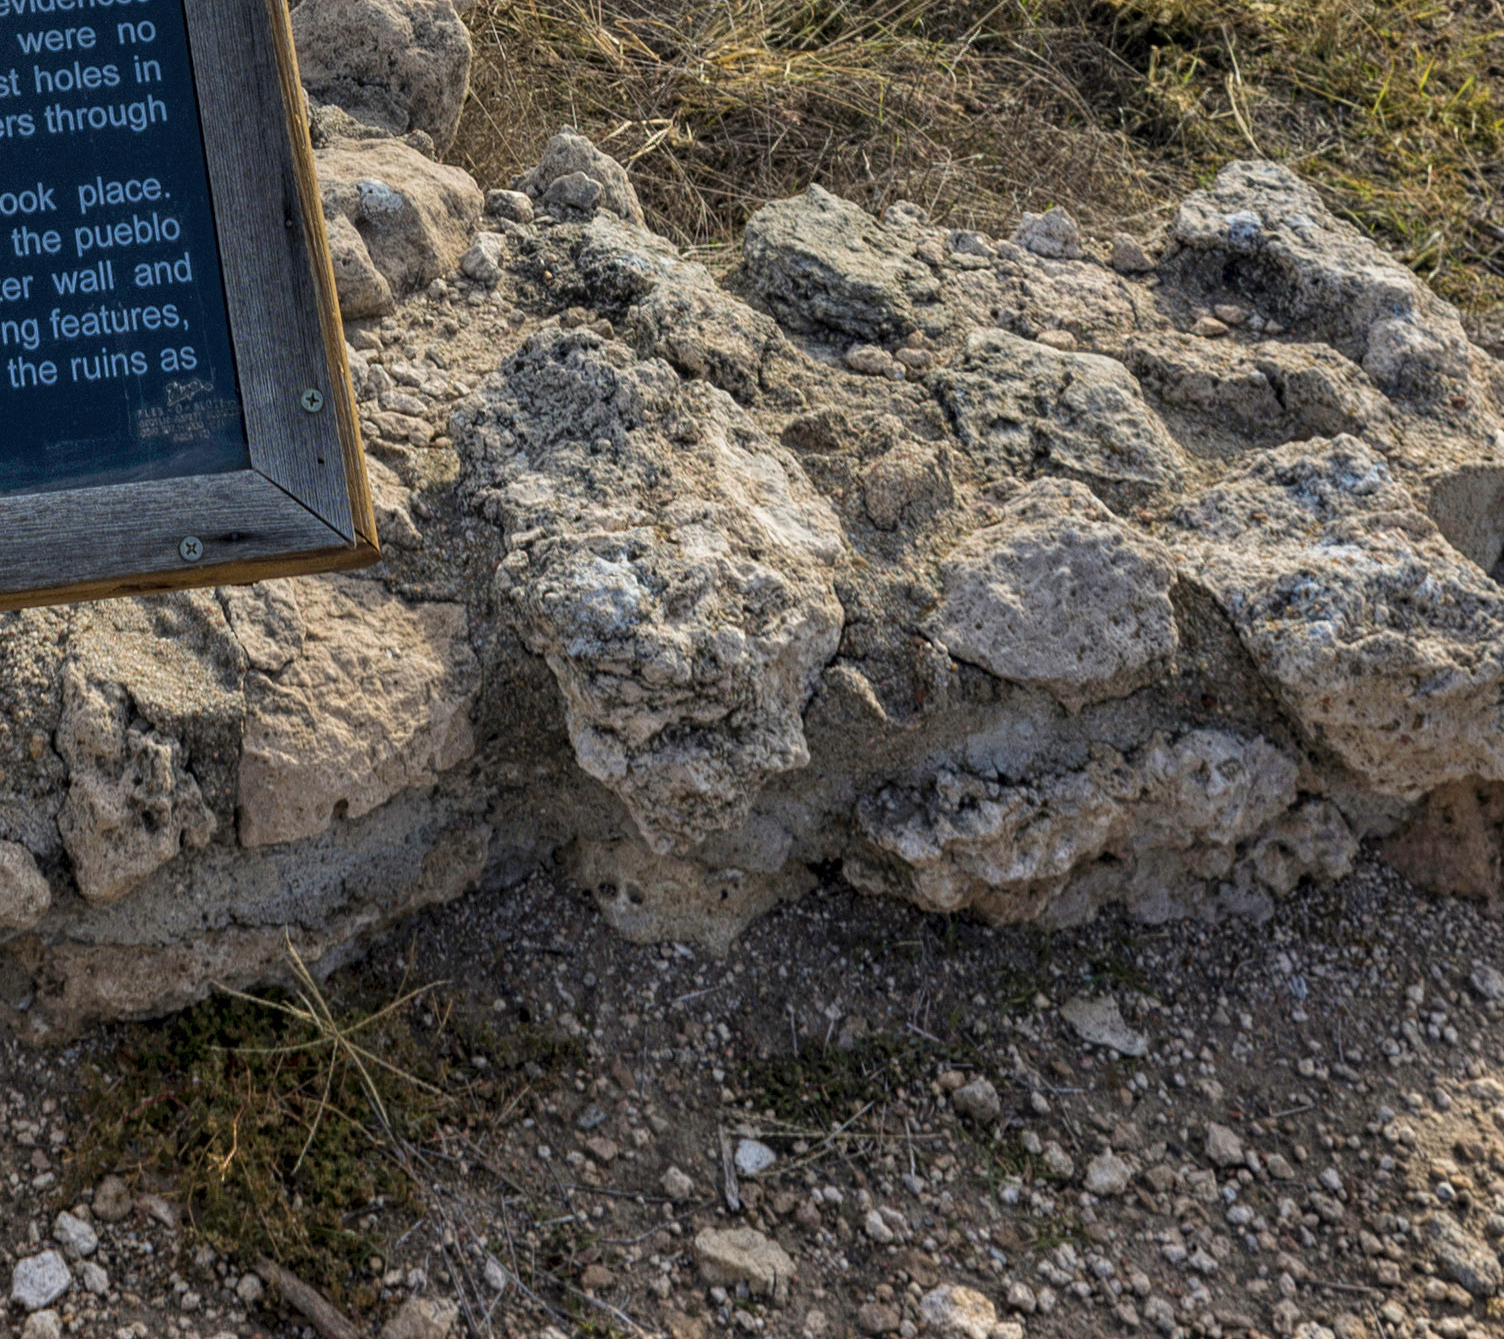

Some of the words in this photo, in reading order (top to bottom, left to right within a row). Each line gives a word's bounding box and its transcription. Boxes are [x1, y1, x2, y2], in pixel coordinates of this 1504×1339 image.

[16, 26, 97, 55] were
[116, 20, 157, 45] no
[33, 60, 121, 94] holes
[133, 54, 162, 84] in
[43, 93, 168, 134] through
[77, 175, 171, 215] place.
[10, 225, 62, 258] the
[74, 211, 181, 258] pueblo
[51, 259, 115, 296] wall
[134, 251, 193, 288] and
[48, 303, 189, 340] features,
[6, 355, 58, 389] the
[70, 346, 148, 382] ruins
[159, 345, 198, 372] as
